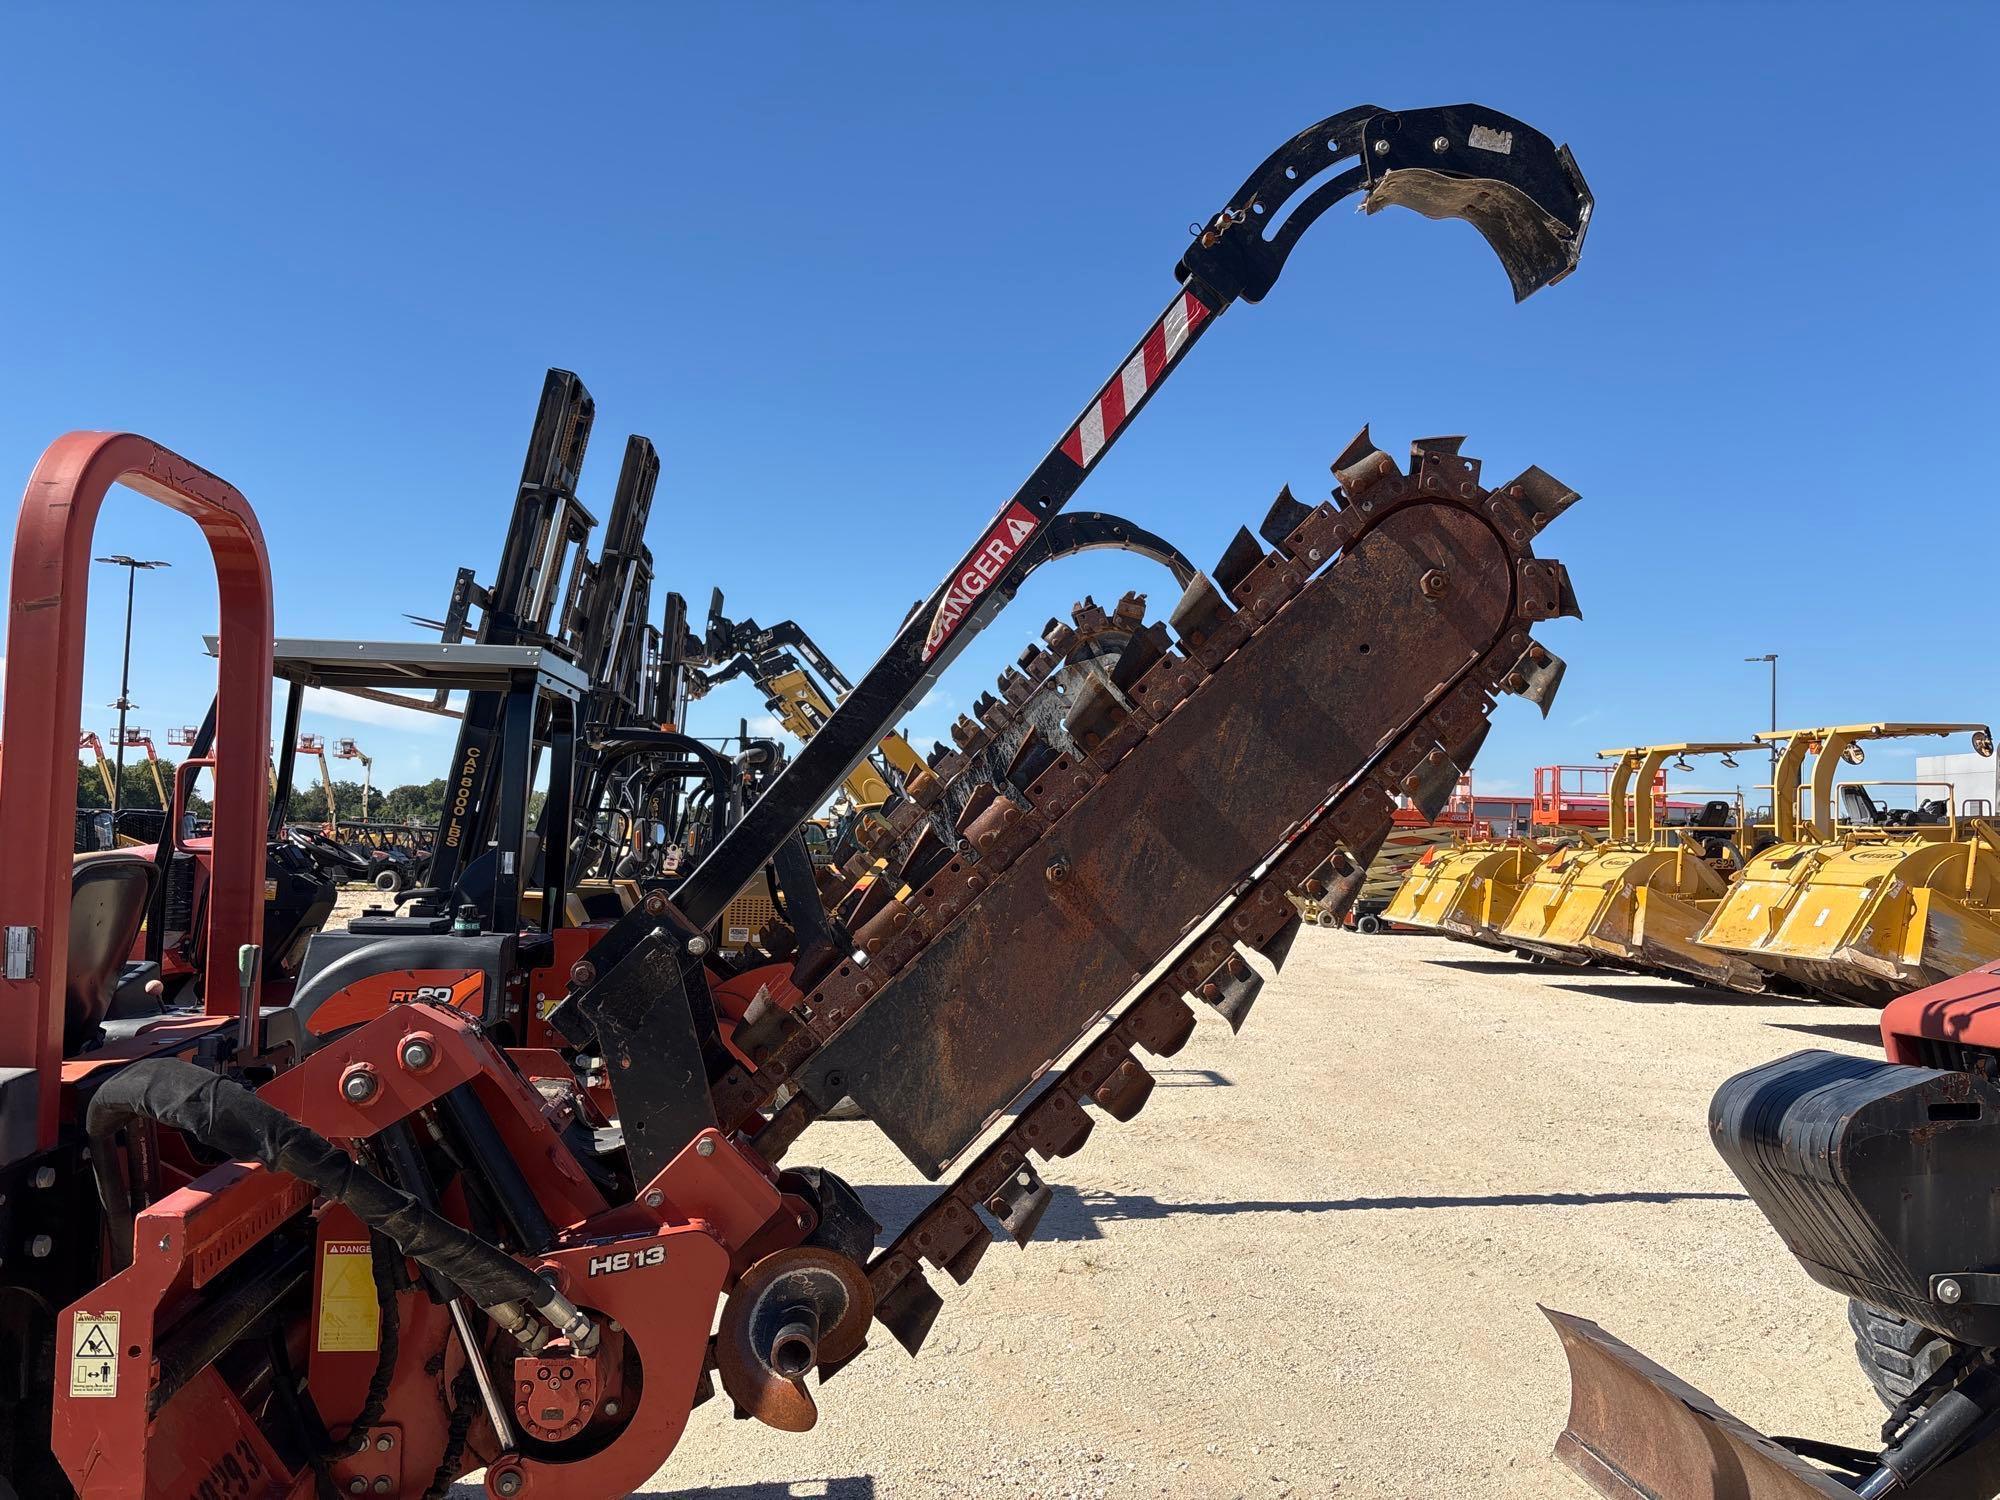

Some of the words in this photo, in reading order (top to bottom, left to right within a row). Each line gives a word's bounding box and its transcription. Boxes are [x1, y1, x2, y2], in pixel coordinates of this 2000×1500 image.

[801, 703, 816, 718] CAT
[463, 747, 481, 776] CAP
[445, 817, 462, 848] LBS
[390, 987, 452, 1004] RT80
[339, 1245, 372, 1254] DANGE
[589, 1246, 666, 1277] H813
